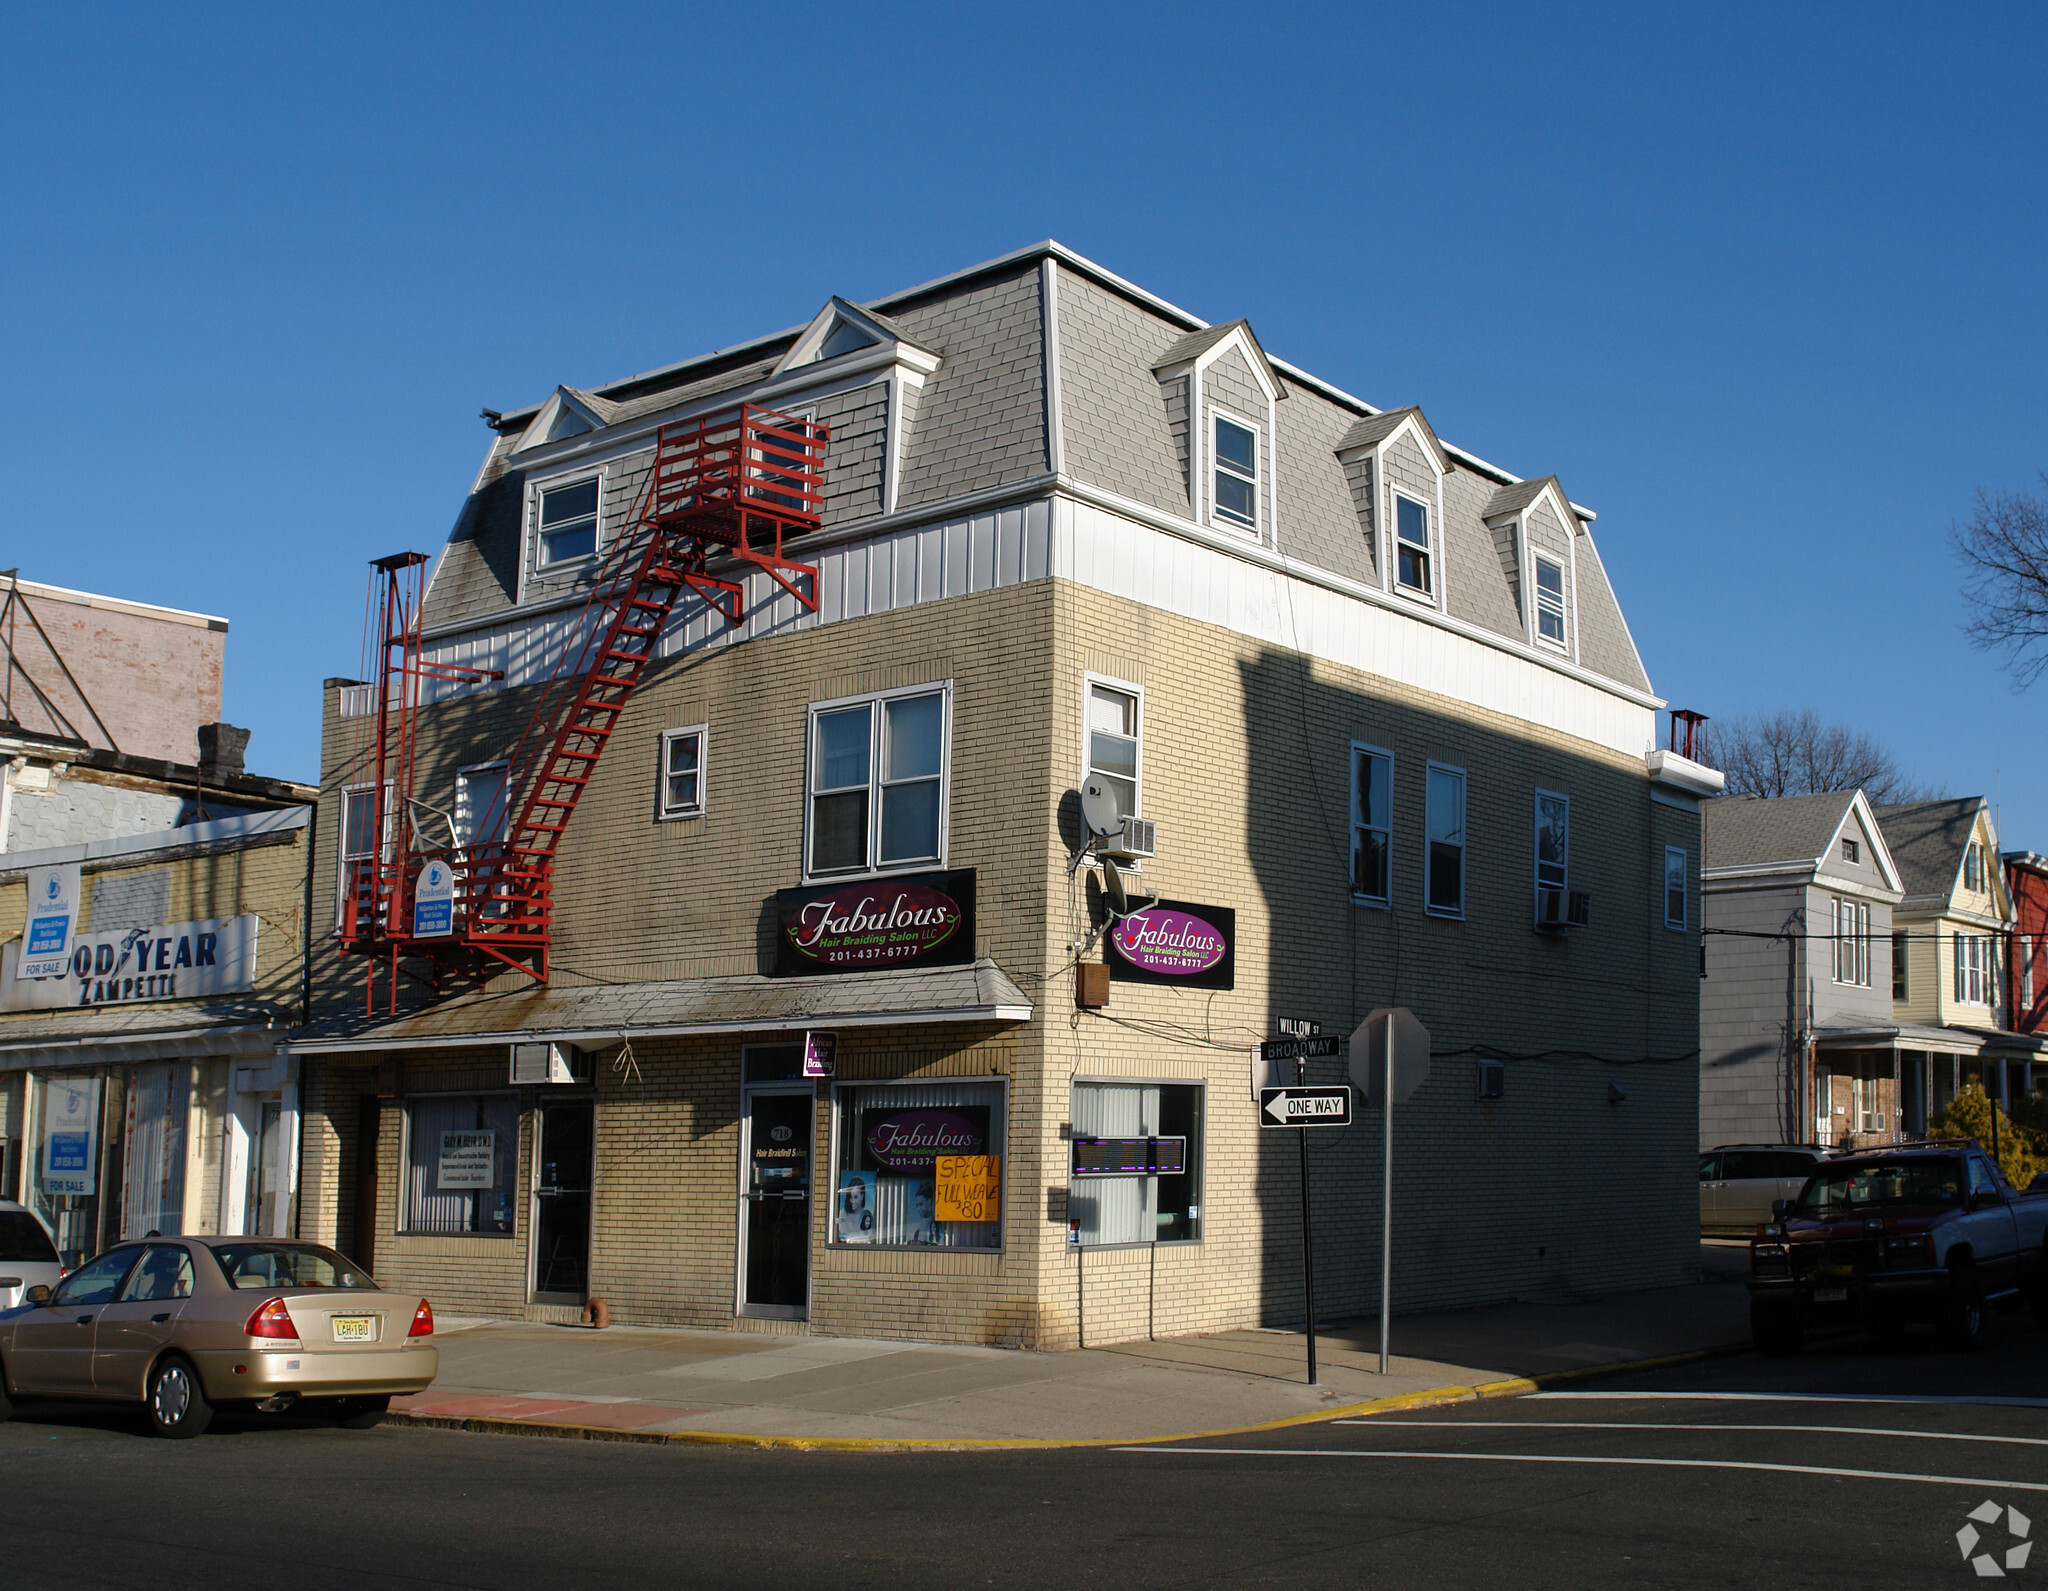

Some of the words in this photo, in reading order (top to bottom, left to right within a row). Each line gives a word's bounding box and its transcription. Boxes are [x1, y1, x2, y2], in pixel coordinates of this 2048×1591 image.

[419, 886, 449, 898] Prudential
[37, 900, 68, 913] Prudential
[796, 893, 947, 947] Fabulous
[819, 938, 841, 948] Hair
[843, 934, 886, 947] Braiding
[889, 931, 918, 943] Salon
[921, 929, 937, 939] LLC
[1123, 915, 1214, 950] Fabulous
[136, 933, 217, 972] YEAR
[829, 945, 918, 962] 201-437-6777
[1140, 945, 1154, 954] Hair
[1155, 946, 1180, 957] Braiding
[1182, 949, 1199, 958] Salon
[1200, 951, 1209, 959] LLC
[1144, 954, 1202, 968] 201-437-6777
[26, 963, 40, 975] FOR
[42, 962, 60, 974] SALE
[79, 973, 177, 1005] ZAMPETTI
[1279, 1018, 1311, 1036] WILLOW
[1313, 1025, 1320, 1034] ST
[810, 1036, 833, 1047] African
[1268, 1039, 1331, 1058] BROADWAY
[814, 1047, 829, 1057] Hair
[807, 1058, 833, 1071] Braiding
[1287, 1100, 1312, 1114] ONE
[1314, 1099, 1340, 1114] WAY
[774, 1129, 789, 1140] 718
[874, 1123, 973, 1153] Fabulous
[756, 1148, 768, 1158] Hair
[791, 1147, 807, 1158] Salon
[891, 1147, 905, 1156] Hair
[907, 1147, 936, 1156] Braiding
[938, 1147, 958, 1155] Salon
[889, 1157, 937, 1166] 201-437-
[940, 1155, 998, 1179] SPECIAL
[50, 1181, 64, 1192] FOR
[65, 1181, 85, 1192] SALE
[936, 1184, 960, 1204] FULL
[962, 1183, 1000, 1201] WEAVE
